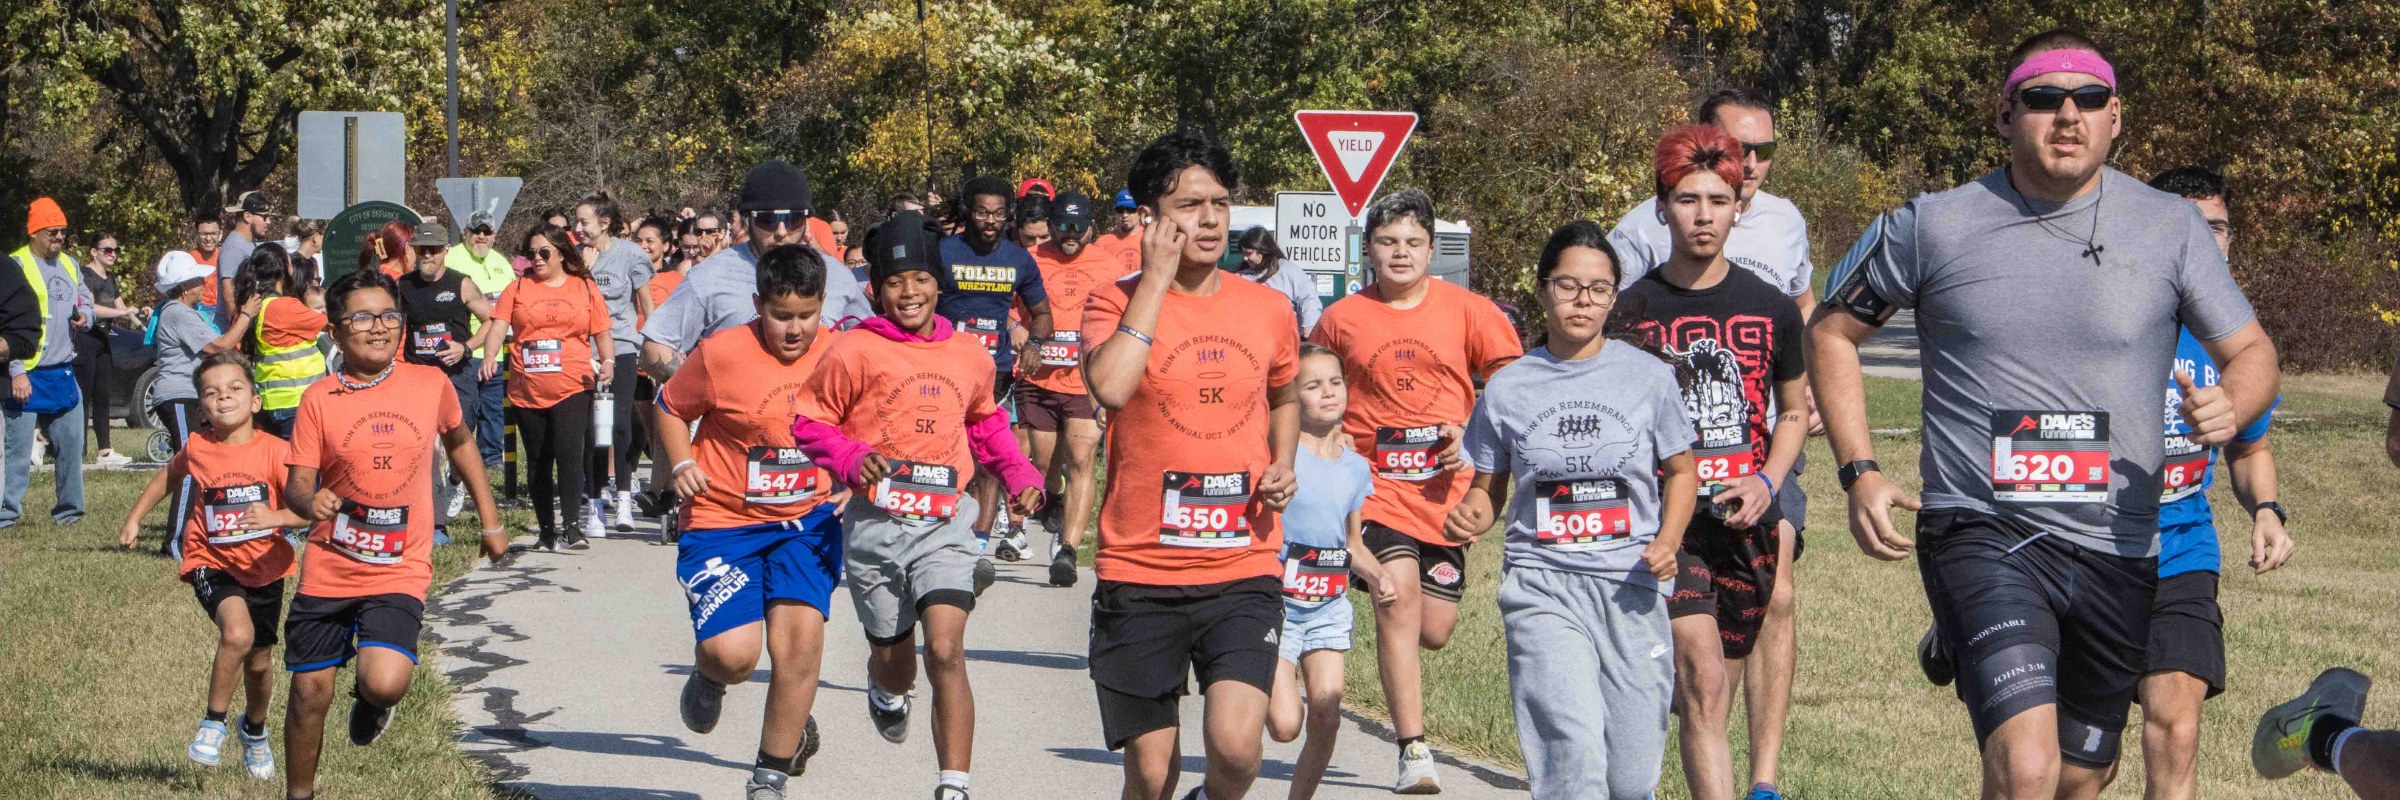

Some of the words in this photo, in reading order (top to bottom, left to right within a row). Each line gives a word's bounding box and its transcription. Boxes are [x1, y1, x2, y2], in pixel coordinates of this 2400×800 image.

[1338, 139, 1373, 151] YIELD
[1303, 203, 1326, 218] NO
[1290, 225, 1338, 240] MOTOR
[1286, 246, 1341, 262] VEHICLES
[952, 264, 1017, 282] TOLEDO
[1725, 256, 1786, 289] EMEMBRANCE
[958, 281, 1012, 292] WRESTLING
[1065, 288, 1076, 297] 5K
[528, 354, 550, 365] 638
[1043, 346, 1069, 357] 630
[1160, 353, 1176, 374] RUN
[1174, 341, 1191, 355] FOR
[1192, 335, 1260, 373] REMEMBRANCE
[886, 387, 901, 405] RUN
[901, 375, 916, 389] FOR
[916, 372, 964, 408] REMEMBRANCE
[1396, 379, 1415, 391] 5K
[756, 398, 770, 416] RUN
[768, 386, 783, 399] FOR
[1199, 387, 1225, 404] 5K
[352, 416, 368, 430] FOR
[368, 411, 422, 441] REMEMBRANCE
[915, 418, 937, 434] 5K
[1168, 418, 1204, 440] ANNUAL
[1520, 420, 1538, 442] RUN
[1537, 406, 1557, 423] FOR
[1559, 400, 1635, 434] REMEMBRANCE
[2041, 412, 2096, 430] DAVE'S
[1405, 426, 1438, 438] DAVE'S
[1703, 425, 1743, 441] DAVE'S
[373, 456, 393, 470] 5K
[1386, 451, 1428, 468] 660
[1565, 455, 1593, 473] 5K
[2010, 454, 2075, 481] 620
[913, 464, 950, 480] DAVE'S
[1203, 473, 1243, 489] DAVE'S
[759, 473, 800, 491] 647
[1572, 480, 1617, 495] DAVE'S
[226, 485, 261, 499] DAVE'S
[886, 491, 932, 514] 624
[367, 507, 402, 520] DAVE'S
[1176, 507, 1228, 530] 650
[1550, 512, 1603, 536] 606
[345, 527, 385, 551] 625
[698, 566, 743, 611] UNDER
[1295, 575, 1329, 595] 425
[697, 573, 750, 630] ARMOUR
[1968, 619, 2028, 647] UNDENIABLE
[1993, 665, 2026, 686] JOHN
[2027, 662, 2046, 672] 3:16
